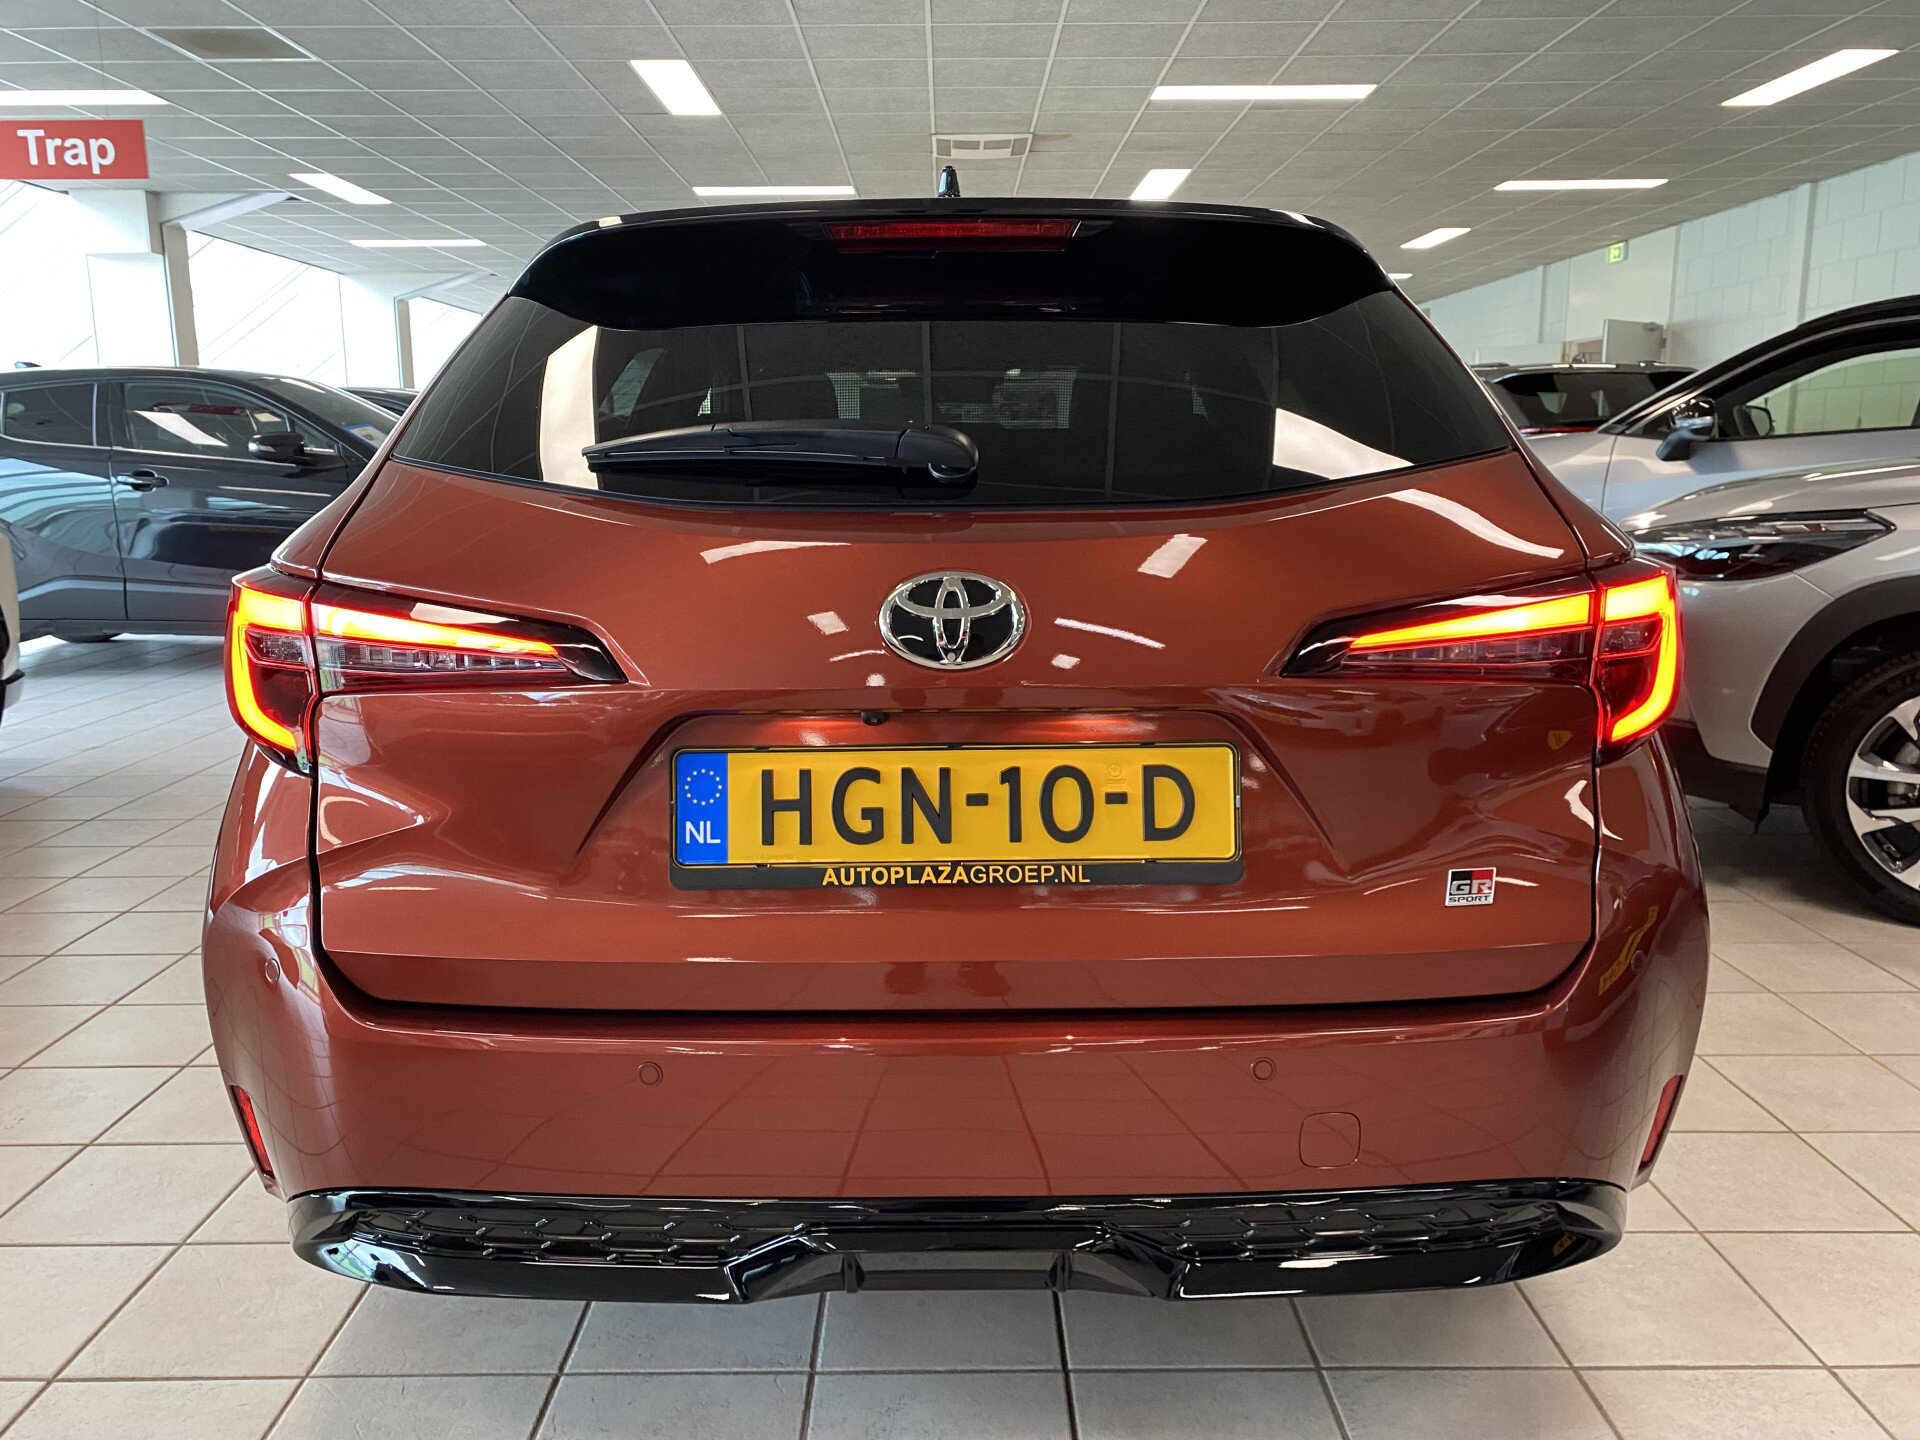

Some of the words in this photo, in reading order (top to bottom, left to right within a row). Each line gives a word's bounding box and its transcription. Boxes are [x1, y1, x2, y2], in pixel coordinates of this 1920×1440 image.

[17, 129, 116, 174] Trap
[761, 765, 1196, 846] HGN-10-D
[685, 821, 721, 844] NL
[822, 865, 1091, 886] AUTOPLAZAGROEP.NL
[1450, 879, 1492, 895] GR
[1448, 895, 1490, 903] SPORT
